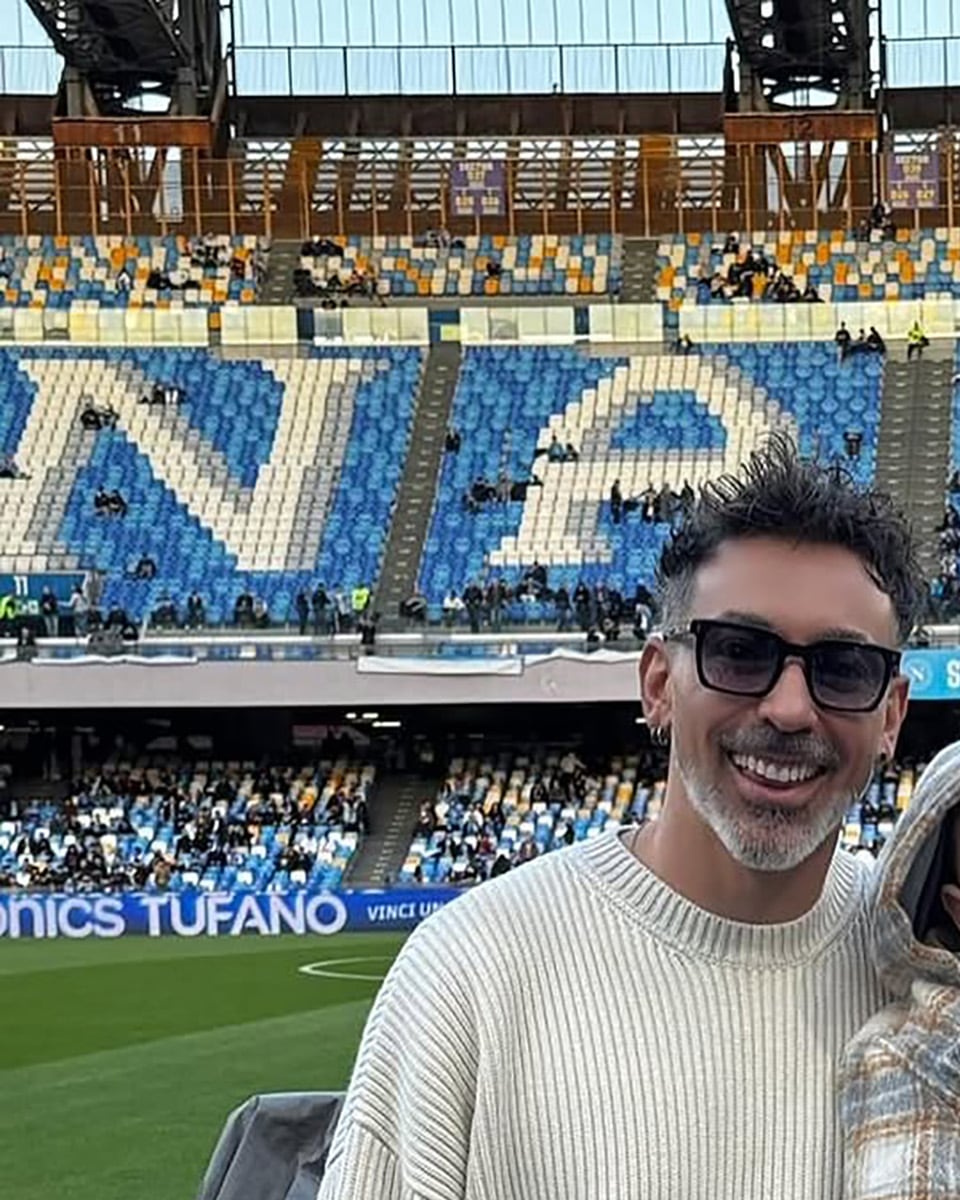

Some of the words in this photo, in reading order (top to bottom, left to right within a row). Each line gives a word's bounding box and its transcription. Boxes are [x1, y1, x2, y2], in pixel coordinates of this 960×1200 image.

[13, 575, 29, 597] 11
[140, 892, 347, 936] TUFANO
[367, 903, 416, 921] VINCI
